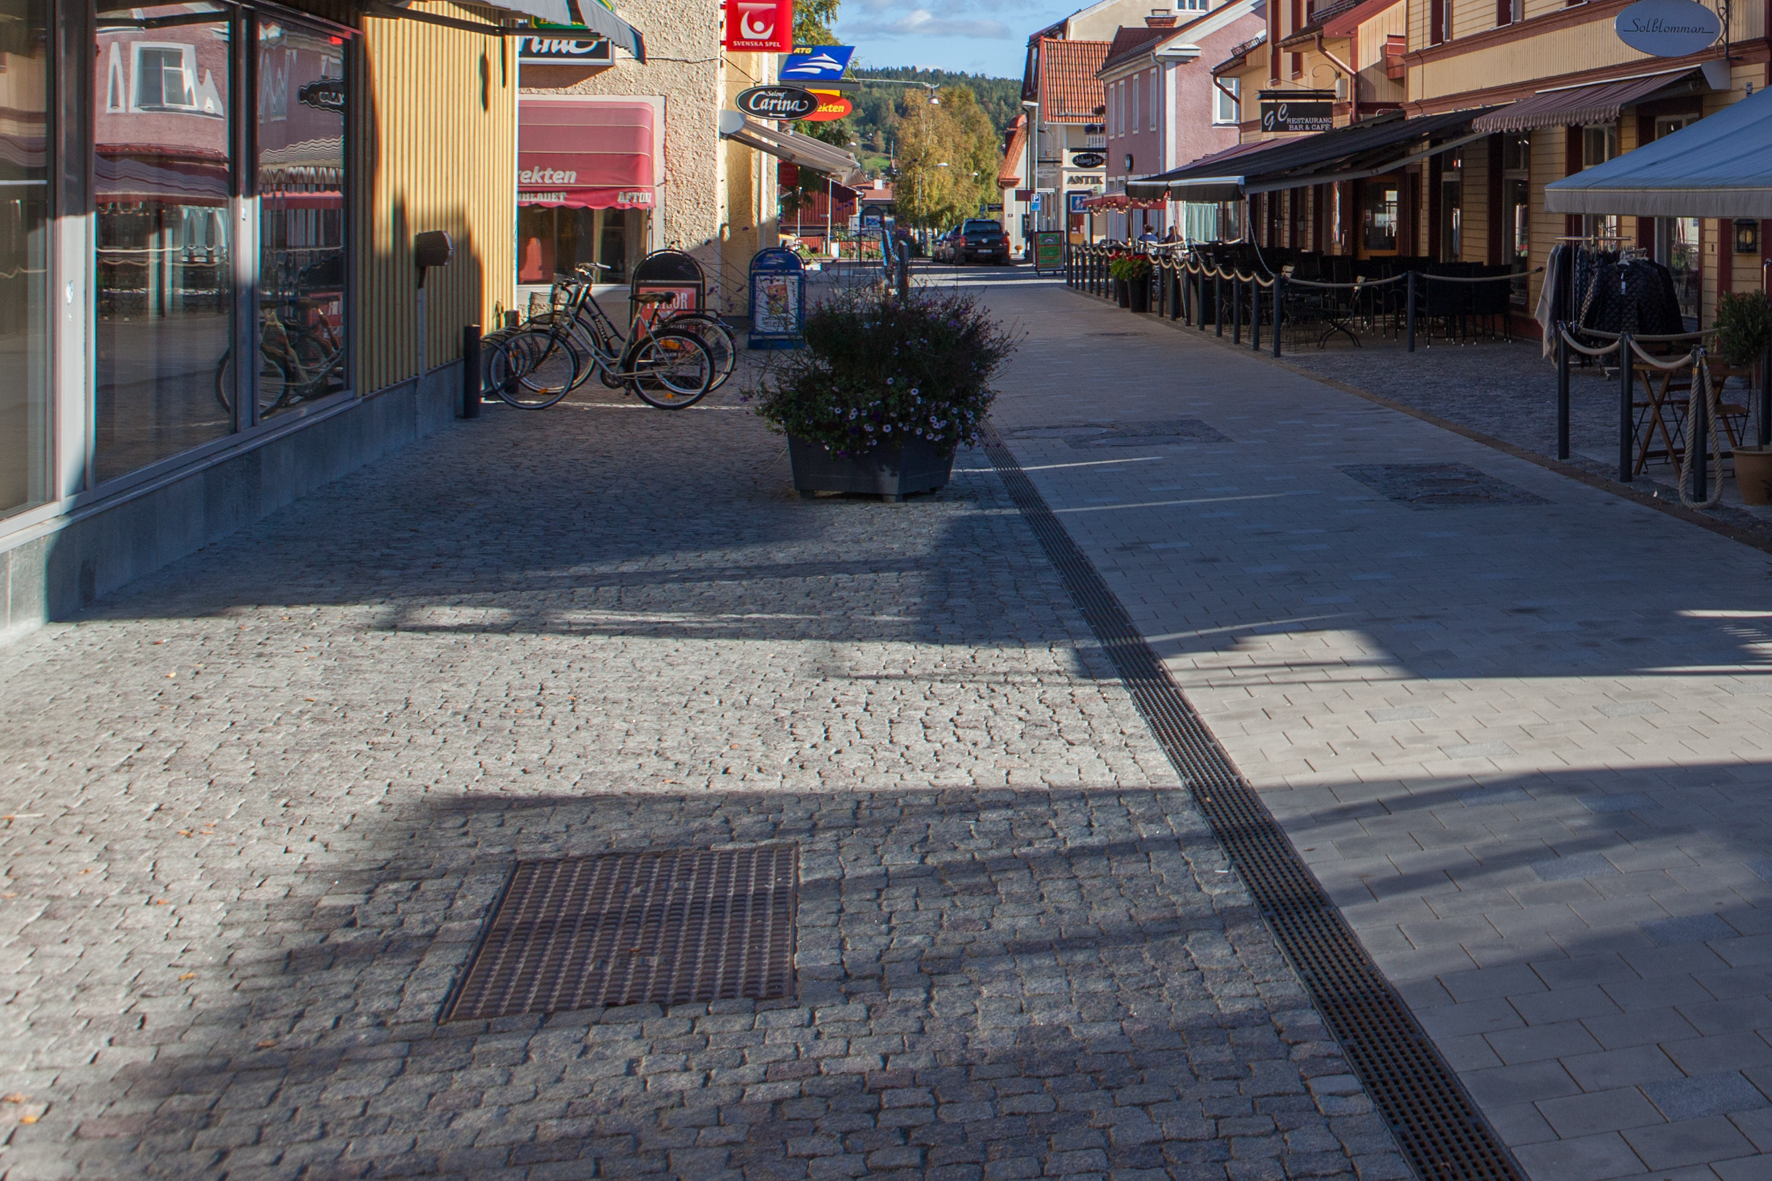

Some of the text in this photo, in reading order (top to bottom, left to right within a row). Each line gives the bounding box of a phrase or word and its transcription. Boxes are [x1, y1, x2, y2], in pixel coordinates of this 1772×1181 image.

[1623, 18, 1714, 34] Solblomman
[733, 40, 764, 48] SVENSKA
[749, 90, 809, 112] Carina
[817, 102, 845, 113] ekten
[1286, 117, 1333, 125] RESTAURANG
[518, 165, 577, 184] ekten
[1067, 175, 1104, 185] ANTIK
